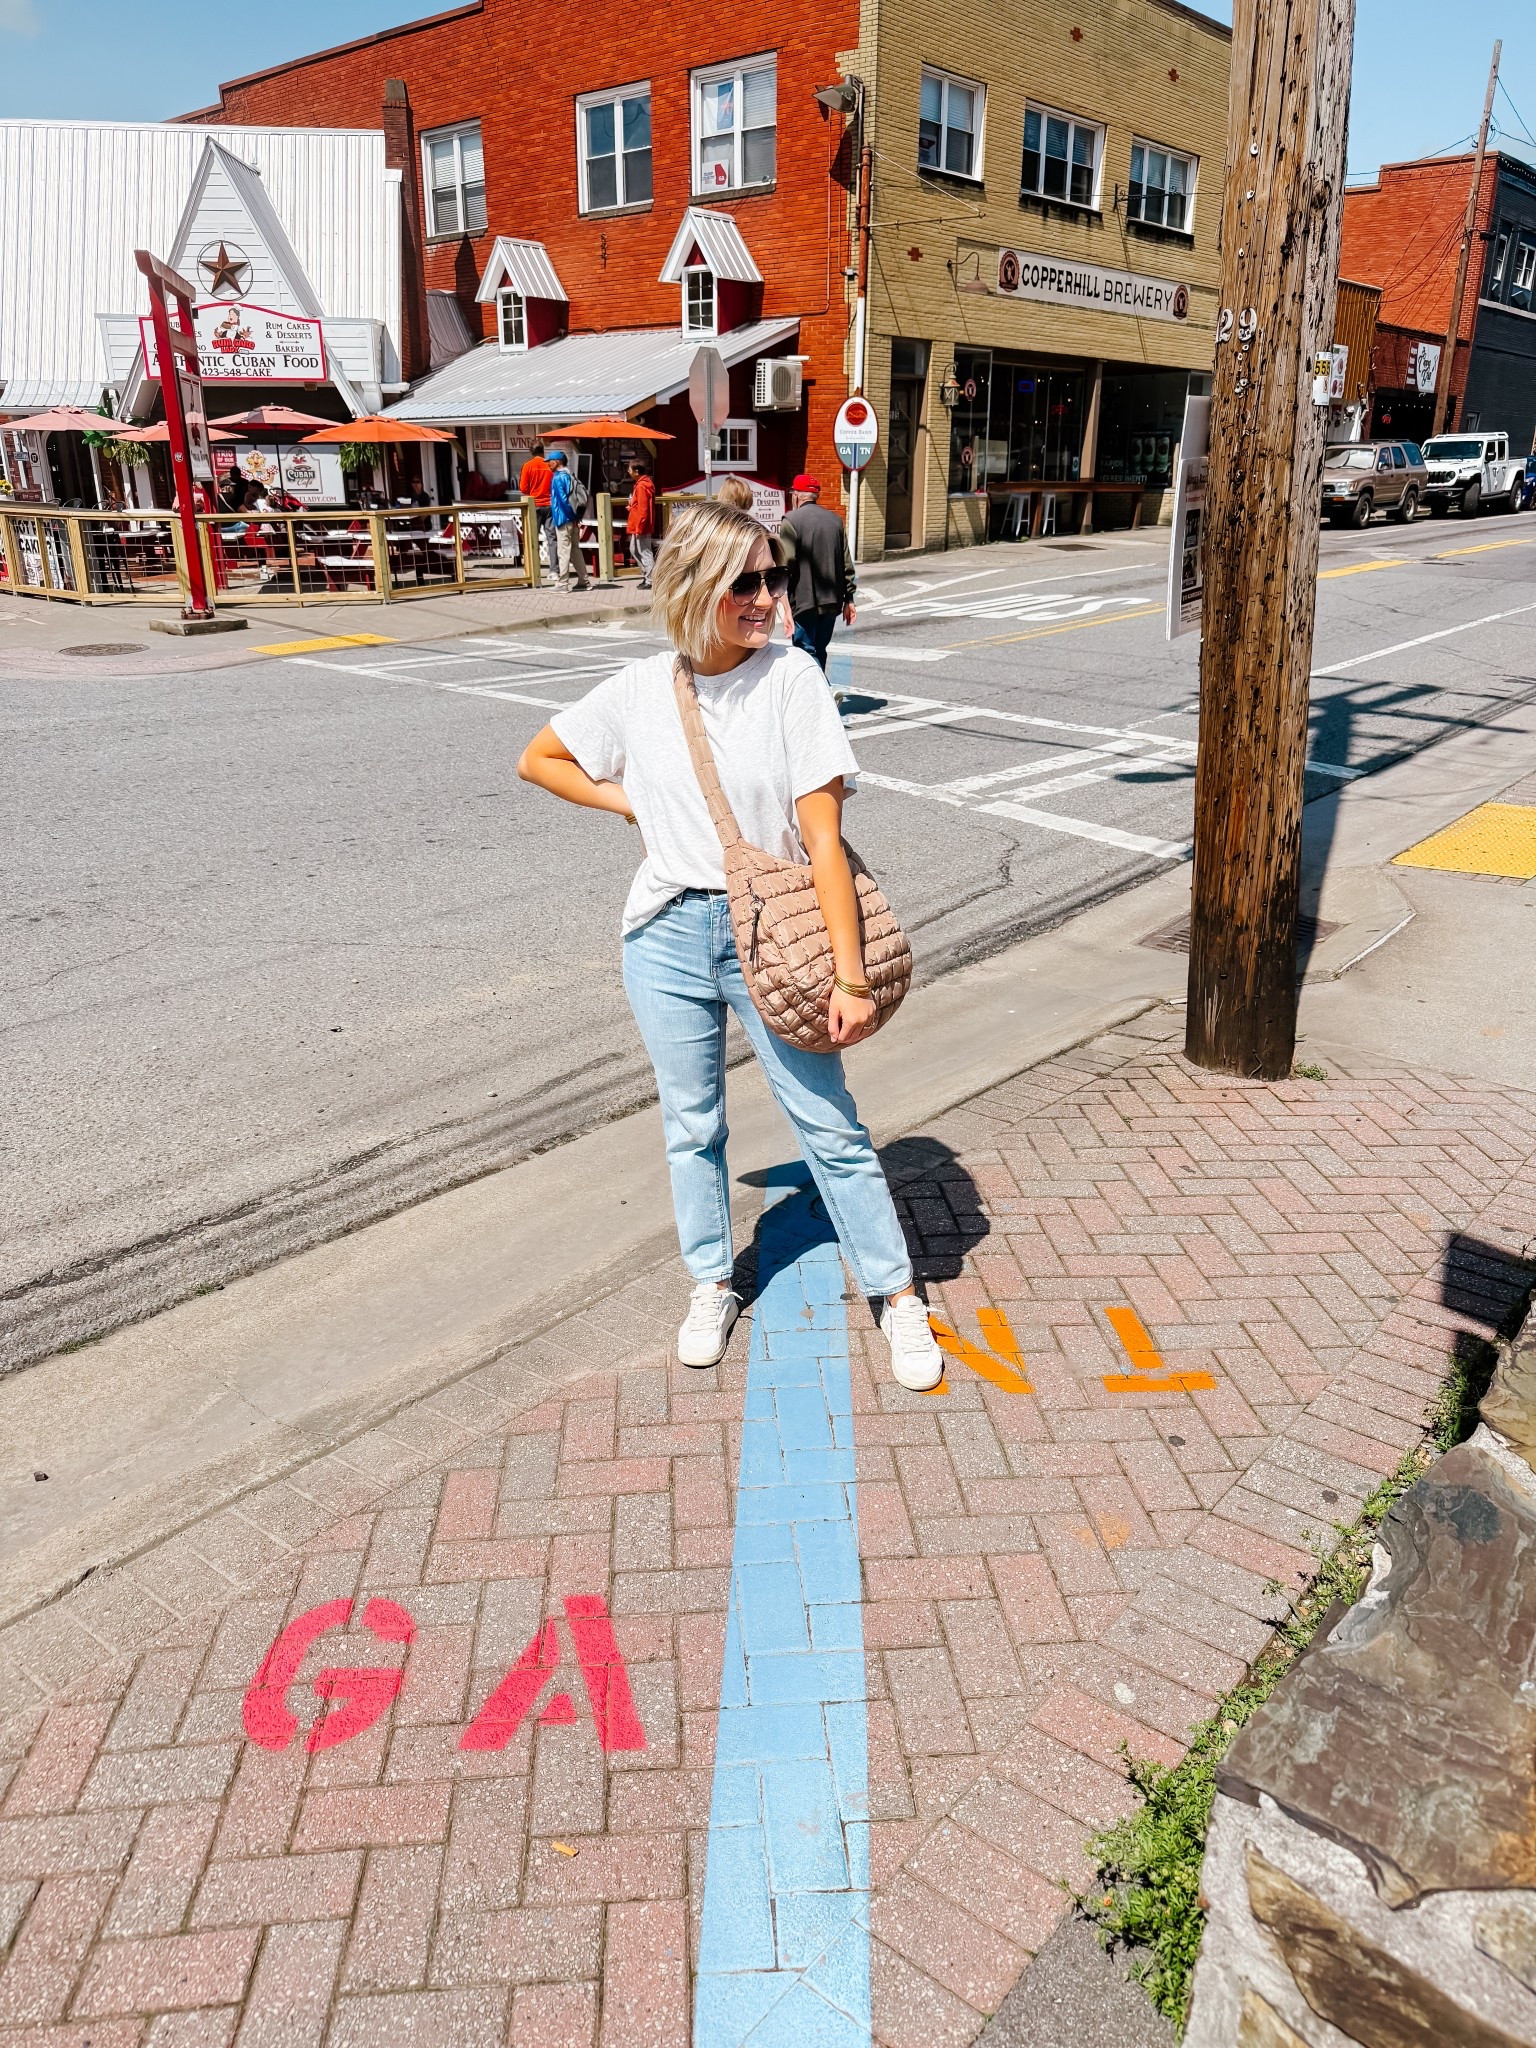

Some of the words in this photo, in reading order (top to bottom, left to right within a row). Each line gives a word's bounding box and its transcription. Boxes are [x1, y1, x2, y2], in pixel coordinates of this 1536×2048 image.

[1021, 263, 1100, 299] COPPERHILL
[1103, 279, 1173, 311] BREWERY
[265, 321, 284, 330] RUM
[286, 322, 311, 331] CAKES
[265, 331, 272, 339] &
[277, 330, 313, 340] DESSERTS
[275, 344, 305, 353] BAKERY
[232, 354, 276, 368] CUBAN
[283, 355, 319, 369] FOOD
[839, 446, 852, 455] GA
[859, 446, 872, 455] TN
[286, 468, 315, 481] CUBAN
[242, 1595, 648, 1752] GA
